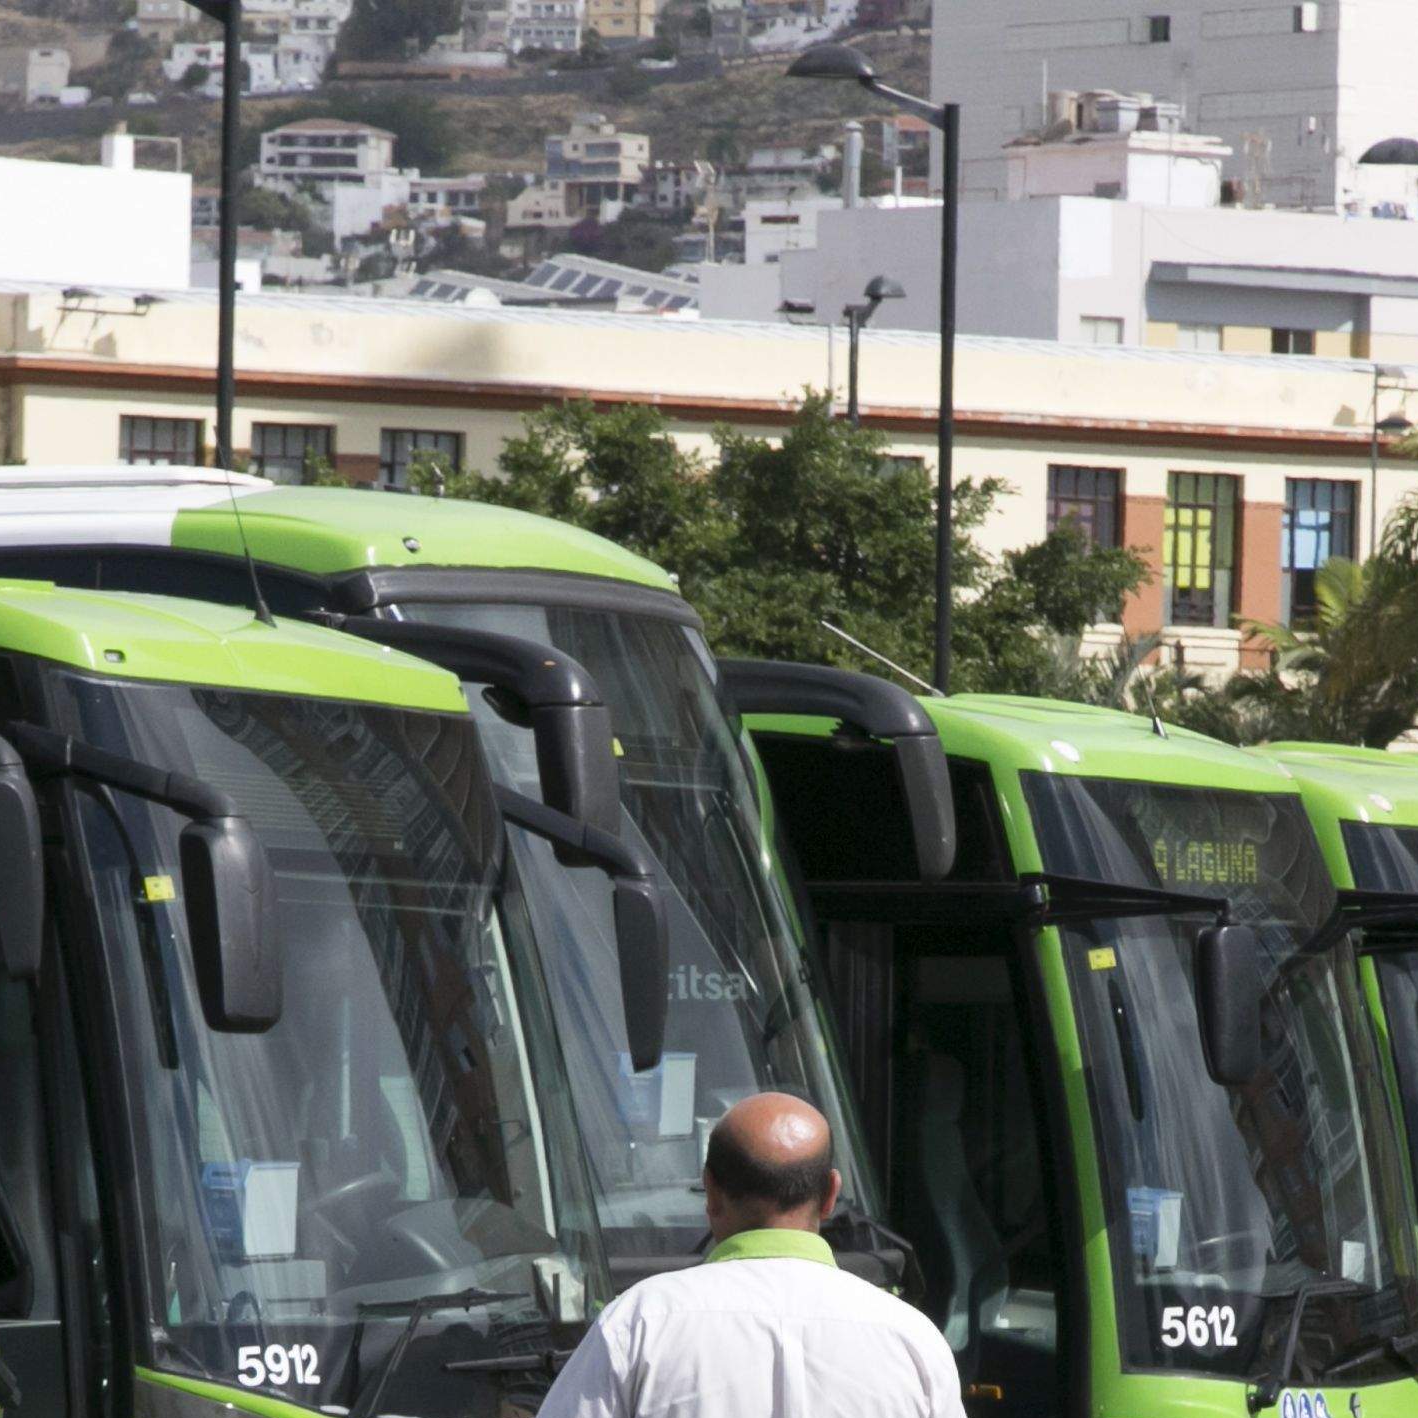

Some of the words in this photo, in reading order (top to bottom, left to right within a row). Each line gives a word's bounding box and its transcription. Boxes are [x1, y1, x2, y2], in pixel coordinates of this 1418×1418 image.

[1175, 840, 1257, 883] LAGUNA
[1161, 1305, 1238, 1347] 5612
[238, 1344, 321, 1387] 5912
